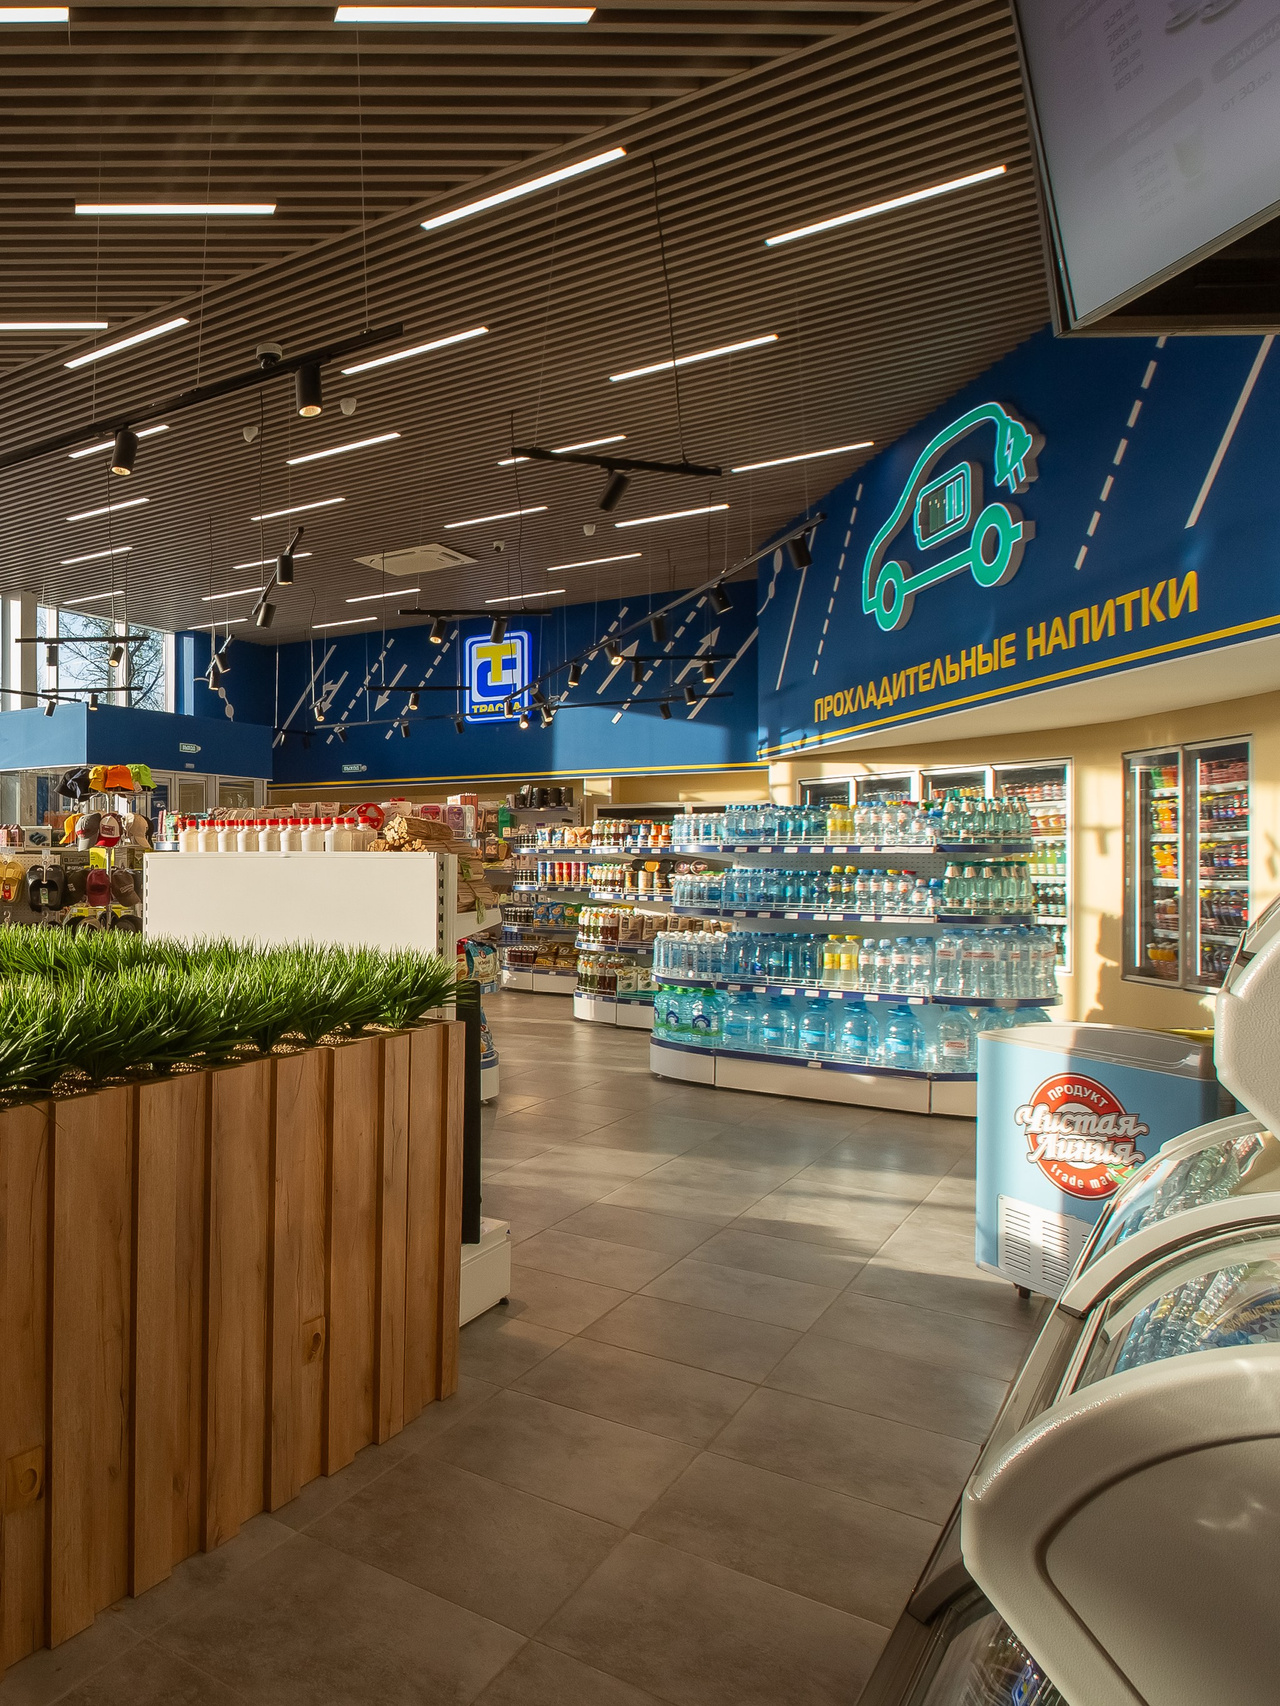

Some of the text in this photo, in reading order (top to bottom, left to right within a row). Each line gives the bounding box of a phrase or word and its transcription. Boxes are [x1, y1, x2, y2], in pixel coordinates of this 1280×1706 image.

[814, 570, 1199, 724] ПРОХЛАДИТЕЛЬНЫЕ НАПИТКИ
[471, 701, 521, 714] ТРАСА
[1047, 1084, 1109, 1107] ПРОДУКТ
[1015, 1103, 1149, 1138] Чистая
[1026, 1133, 1146, 1165] Линия
[1050, 1163, 1119, 1189] trade mark
